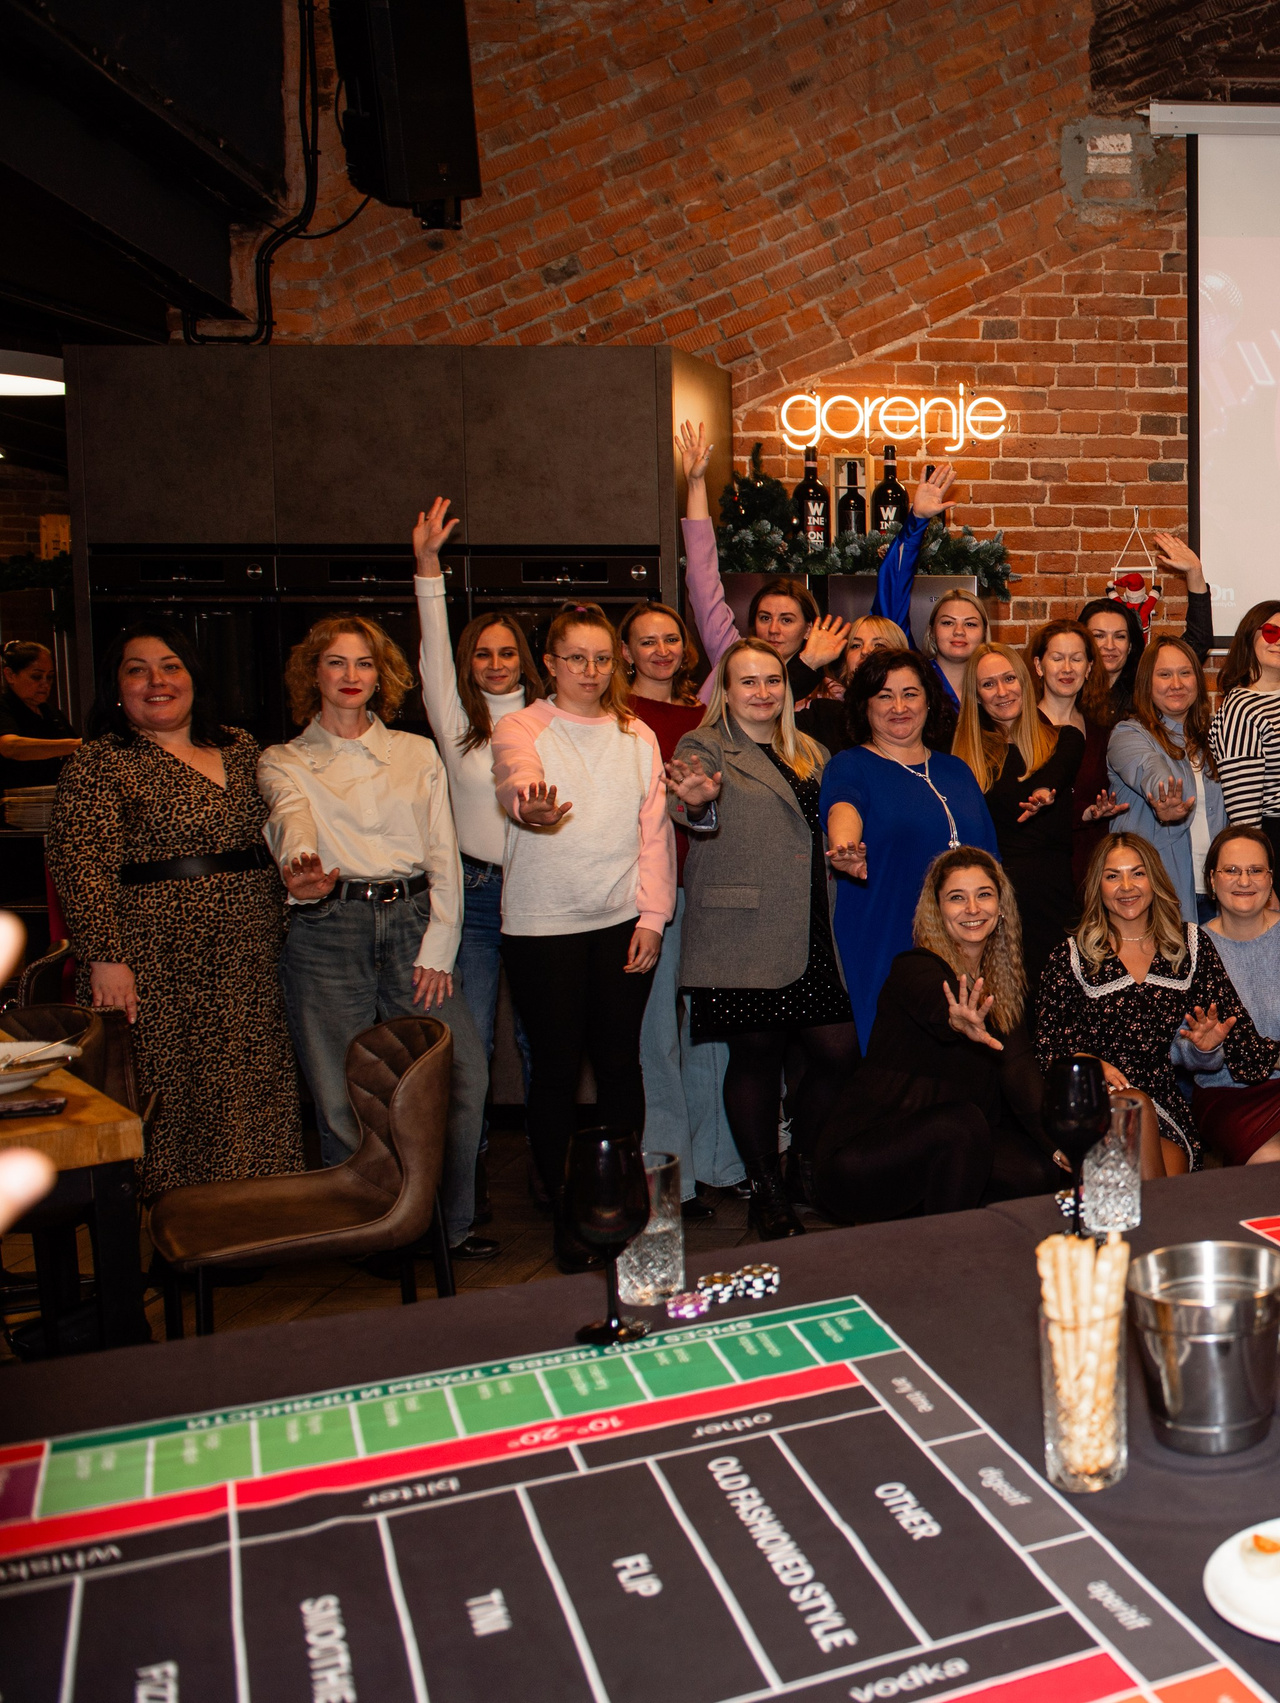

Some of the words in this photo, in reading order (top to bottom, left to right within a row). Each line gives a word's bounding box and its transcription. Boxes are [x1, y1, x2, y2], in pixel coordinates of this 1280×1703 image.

[780, 382, 1007, 452] gorenje
[808, 531, 824, 541] ON
[603, 1338, 657, 1357] AND
[664, 1320, 752, 1344] SPICES
[360, 1387, 382, 1401] И
[388, 1368, 488, 1394] ТРАВЫ
[187, 1392, 353, 1430] ПРЯНОСТИ
[693, 1412, 773, 1438] other
[363, 1477, 460, 1508] bitter
[707, 1455, 751, 1492] OLD
[978, 1466, 1033, 1506] digestif
[874, 1481, 942, 1541] OTHER
[726, 1486, 815, 1588] FASHIONED
[612, 1553, 663, 1597] FLIP
[789, 1581, 859, 1654] STYLE
[1087, 1579, 1152, 1630] aperitif
[849, 1657, 970, 1703] vodka
